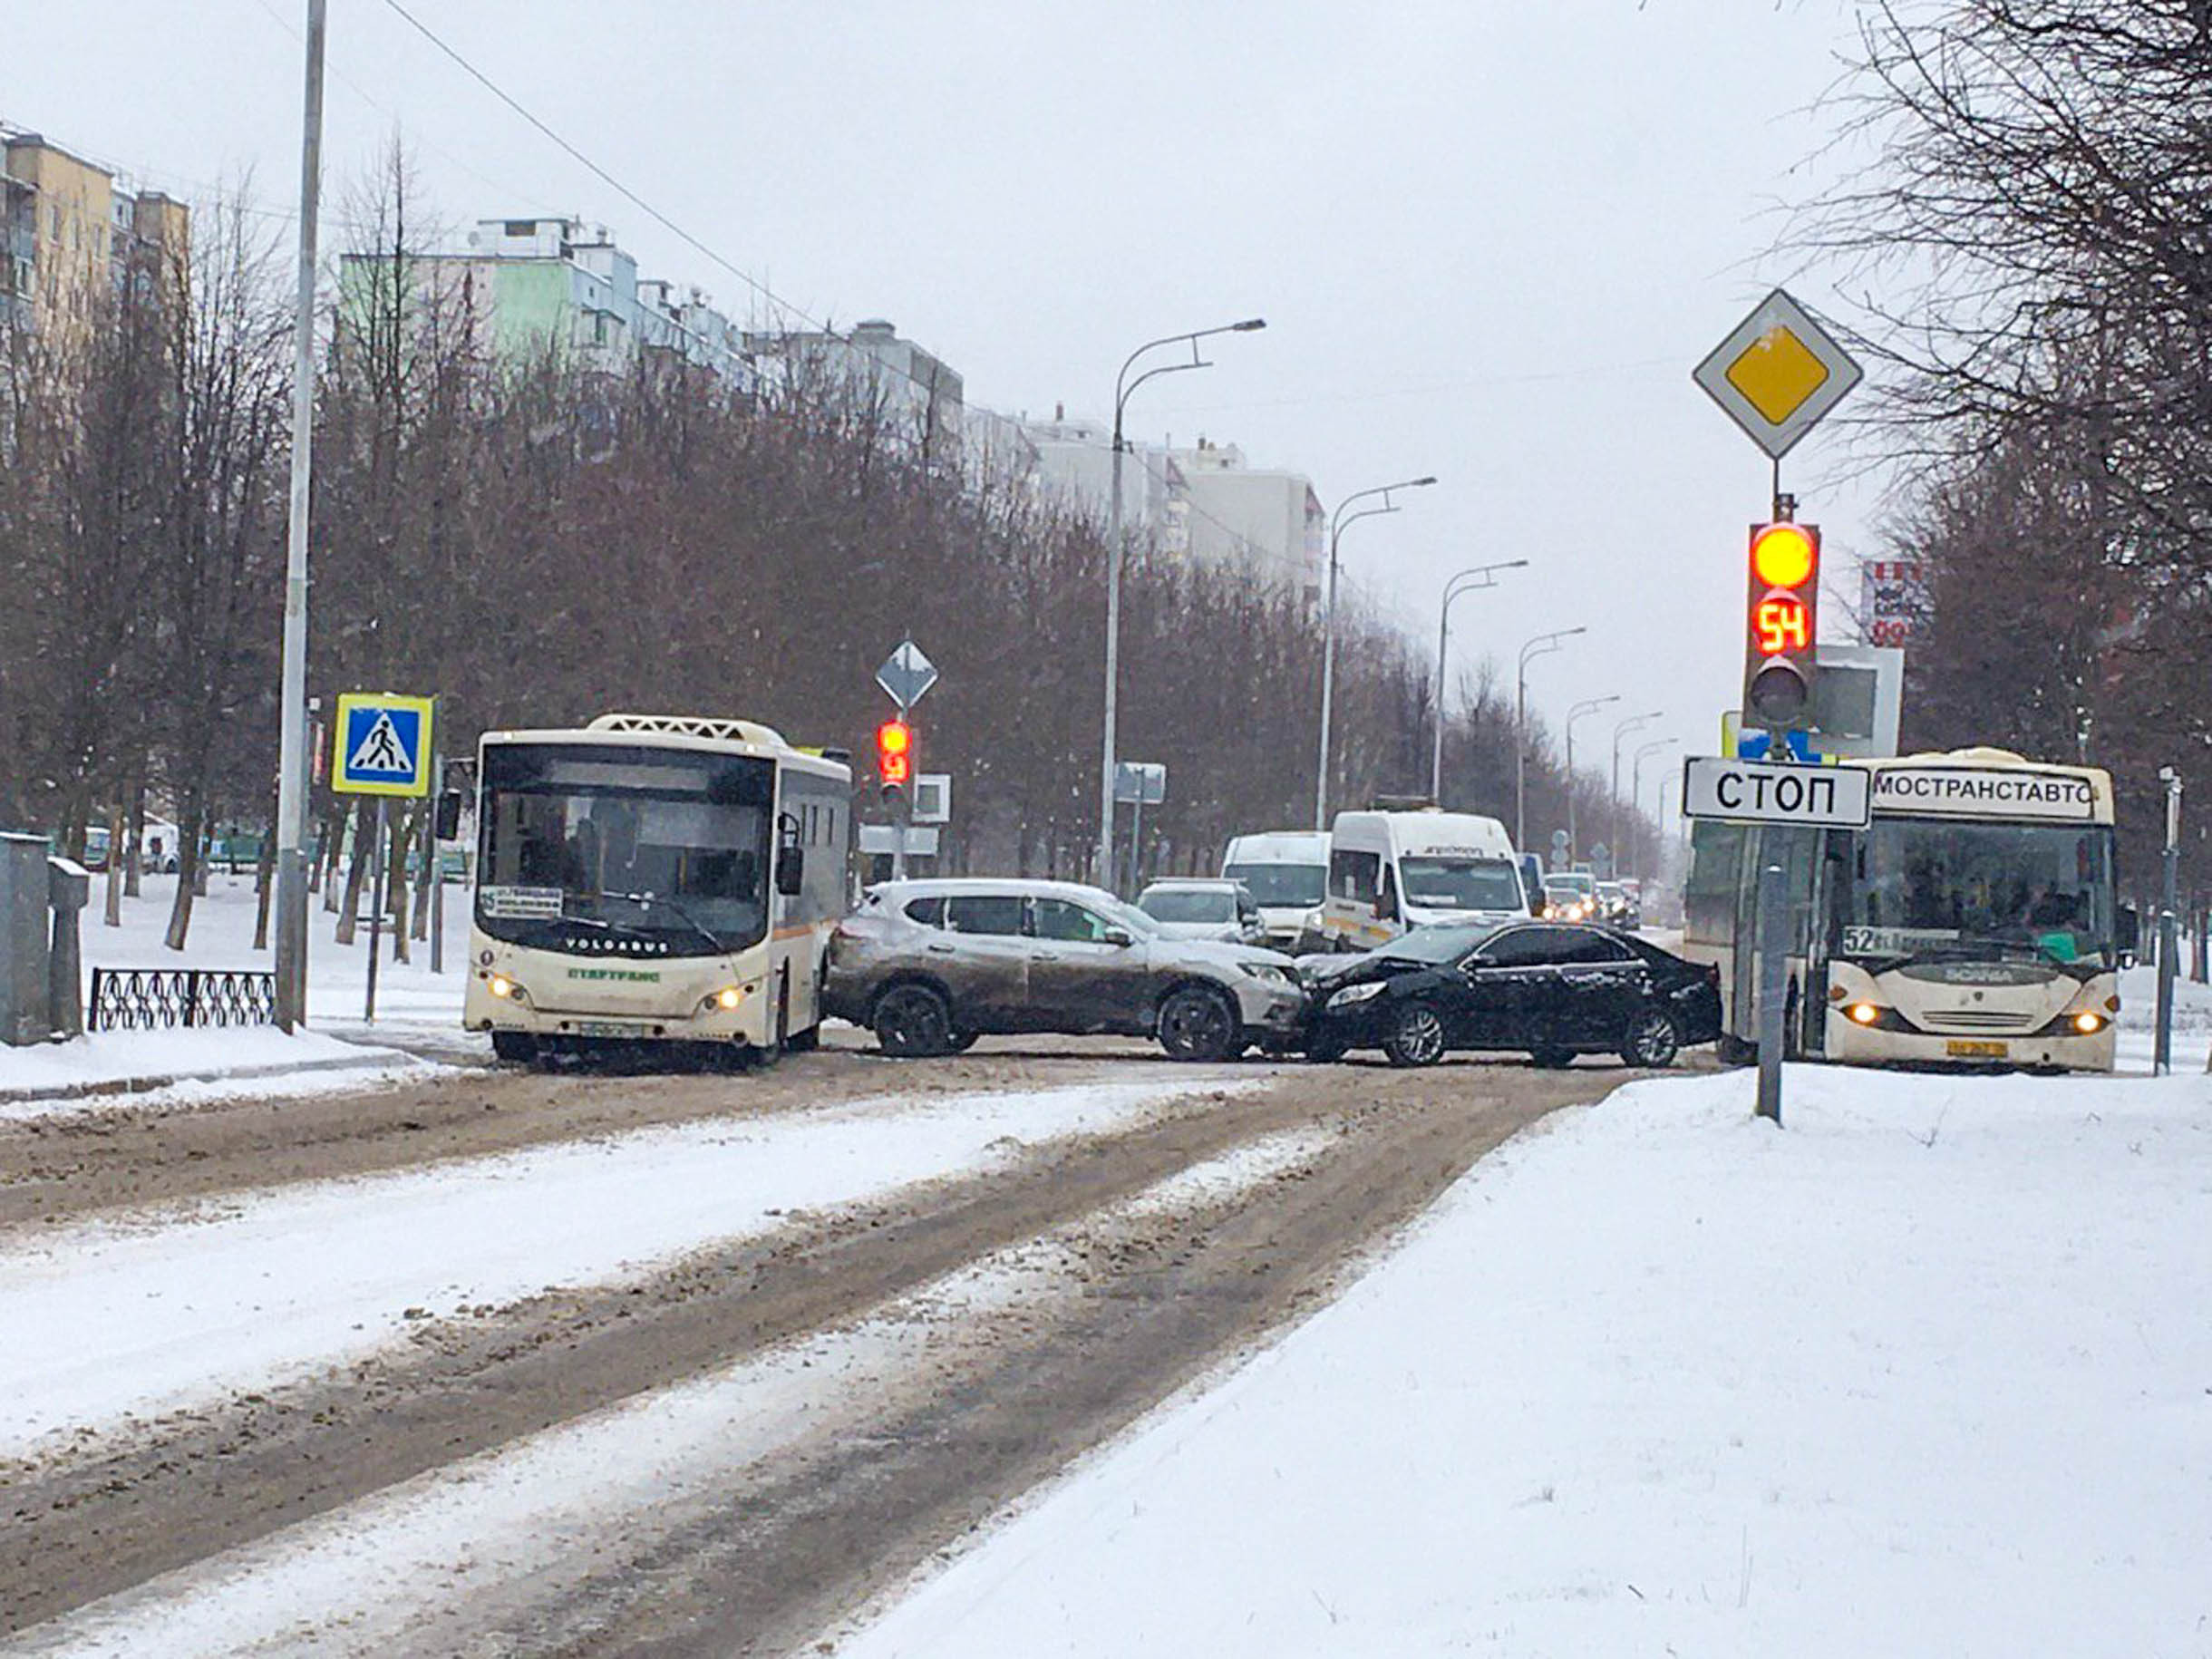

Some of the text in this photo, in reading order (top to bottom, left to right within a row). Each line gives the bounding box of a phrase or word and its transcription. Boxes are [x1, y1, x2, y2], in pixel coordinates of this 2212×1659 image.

[1760, 604, 1805, 650] 54
[1717, 772, 1834, 813] СТОП
[1873, 776, 2093, 803] МОСТРАНСТАВТО
[566, 938, 668, 953] VOLGABUS
[1845, 928, 1872, 953] 52
